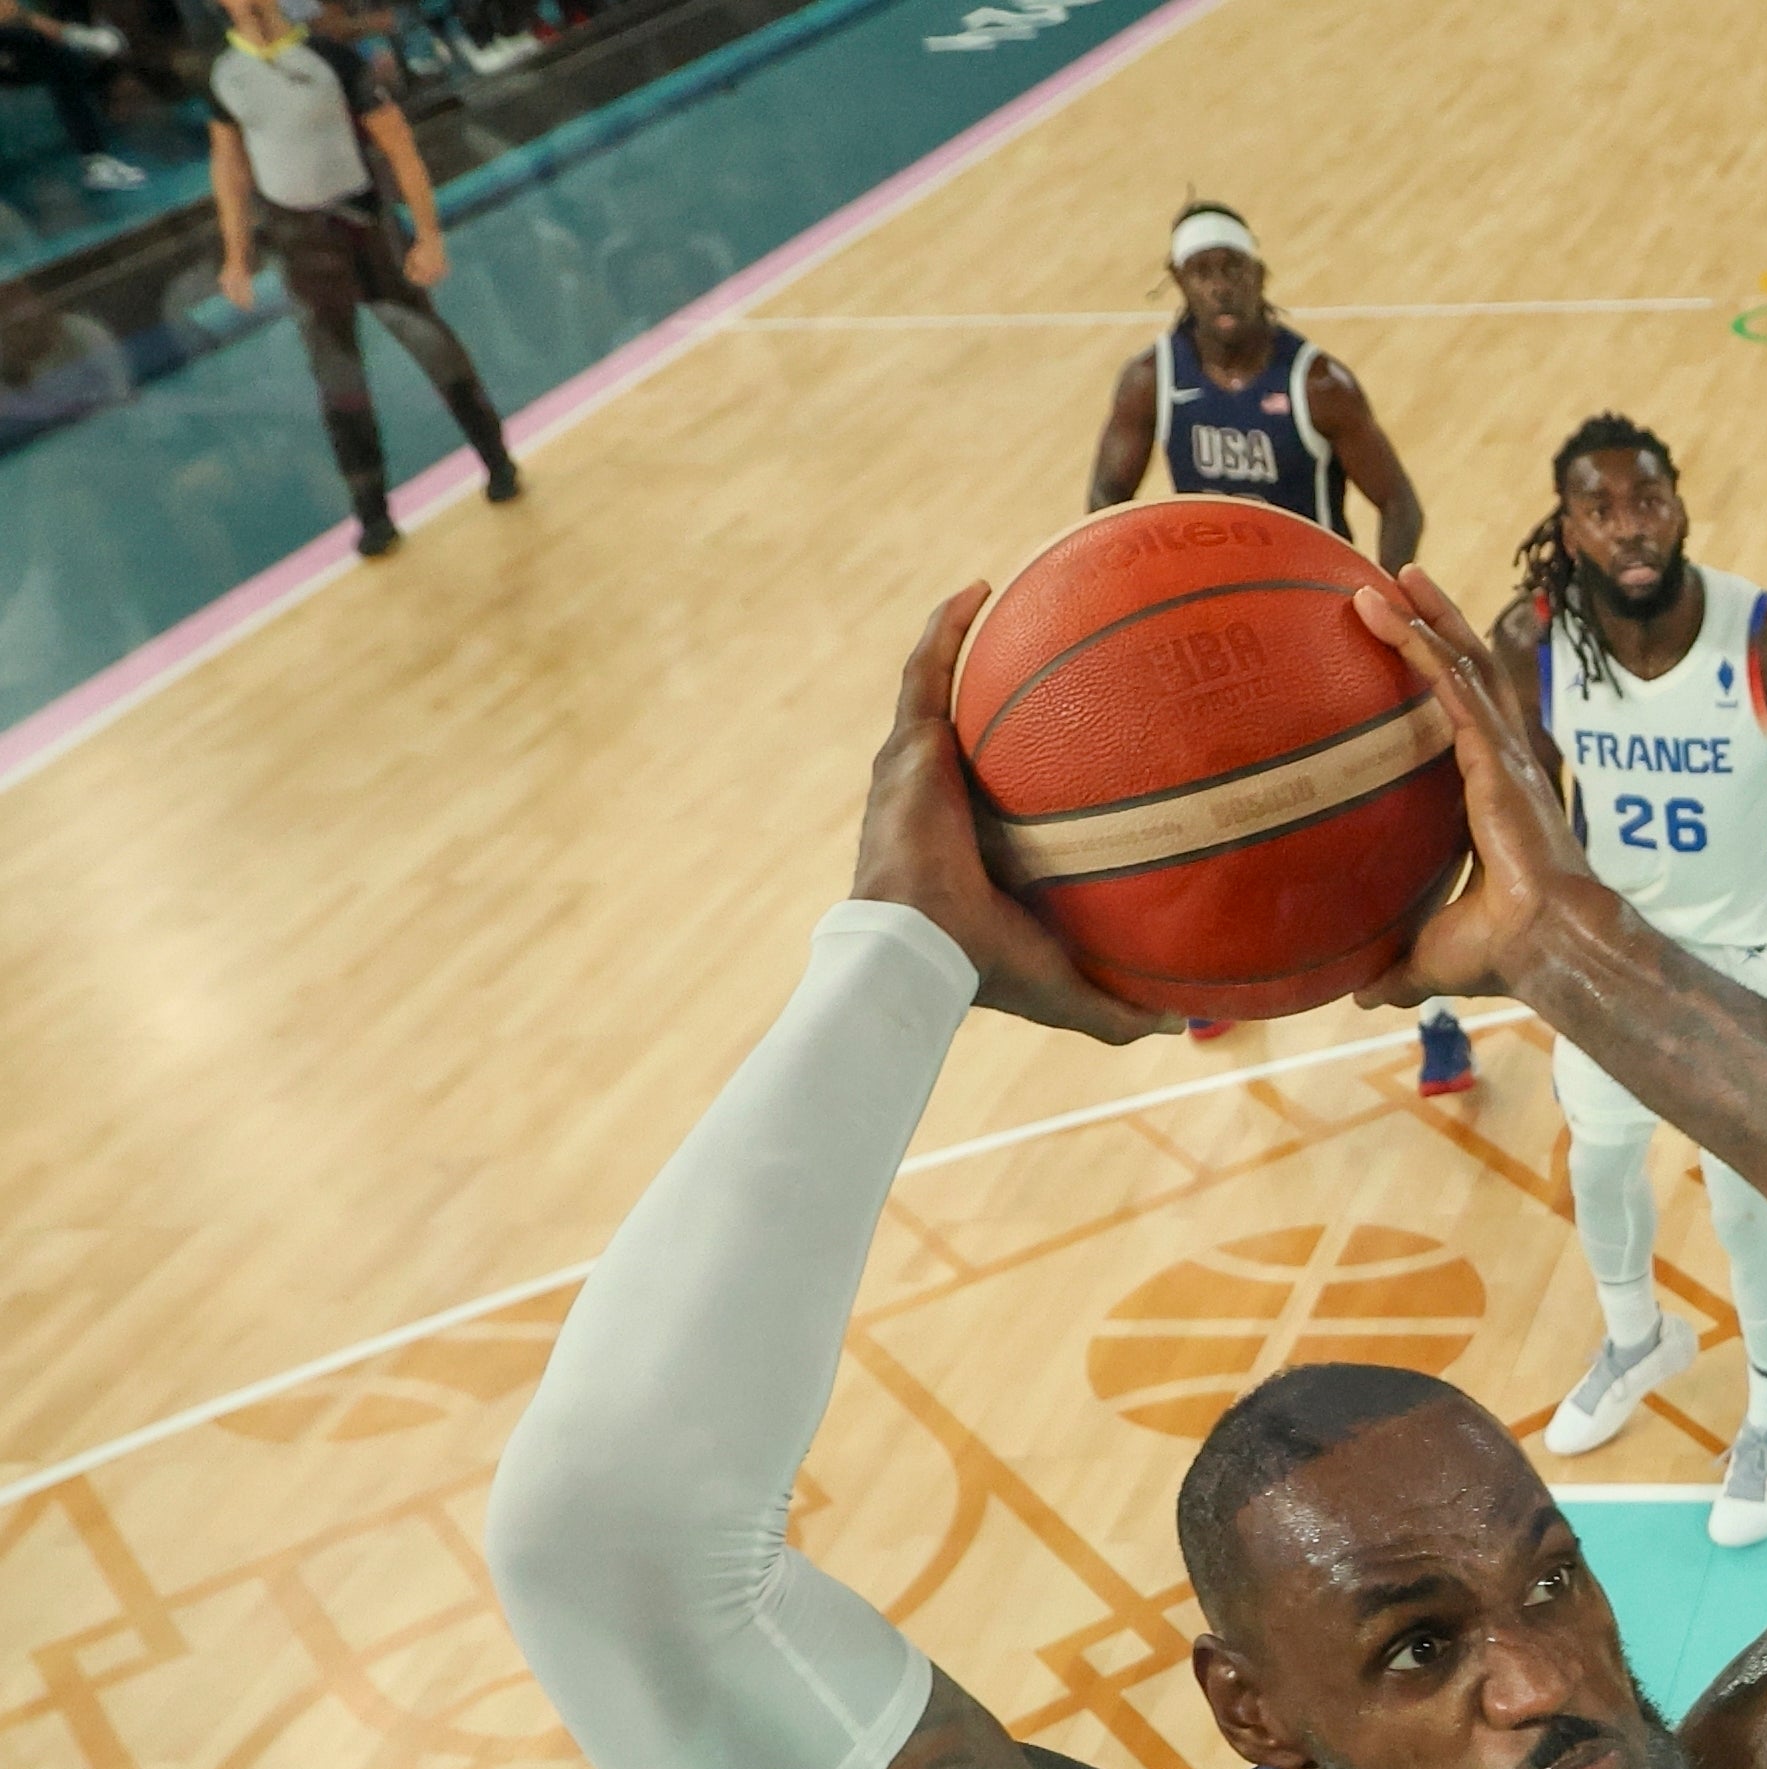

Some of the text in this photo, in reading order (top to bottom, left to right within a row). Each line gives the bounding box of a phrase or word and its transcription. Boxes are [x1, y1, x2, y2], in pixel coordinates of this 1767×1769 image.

[1191, 424, 1279, 485] USA
[1574, 729, 1734, 774] FRANCE
[1614, 793, 1708, 852] 26
